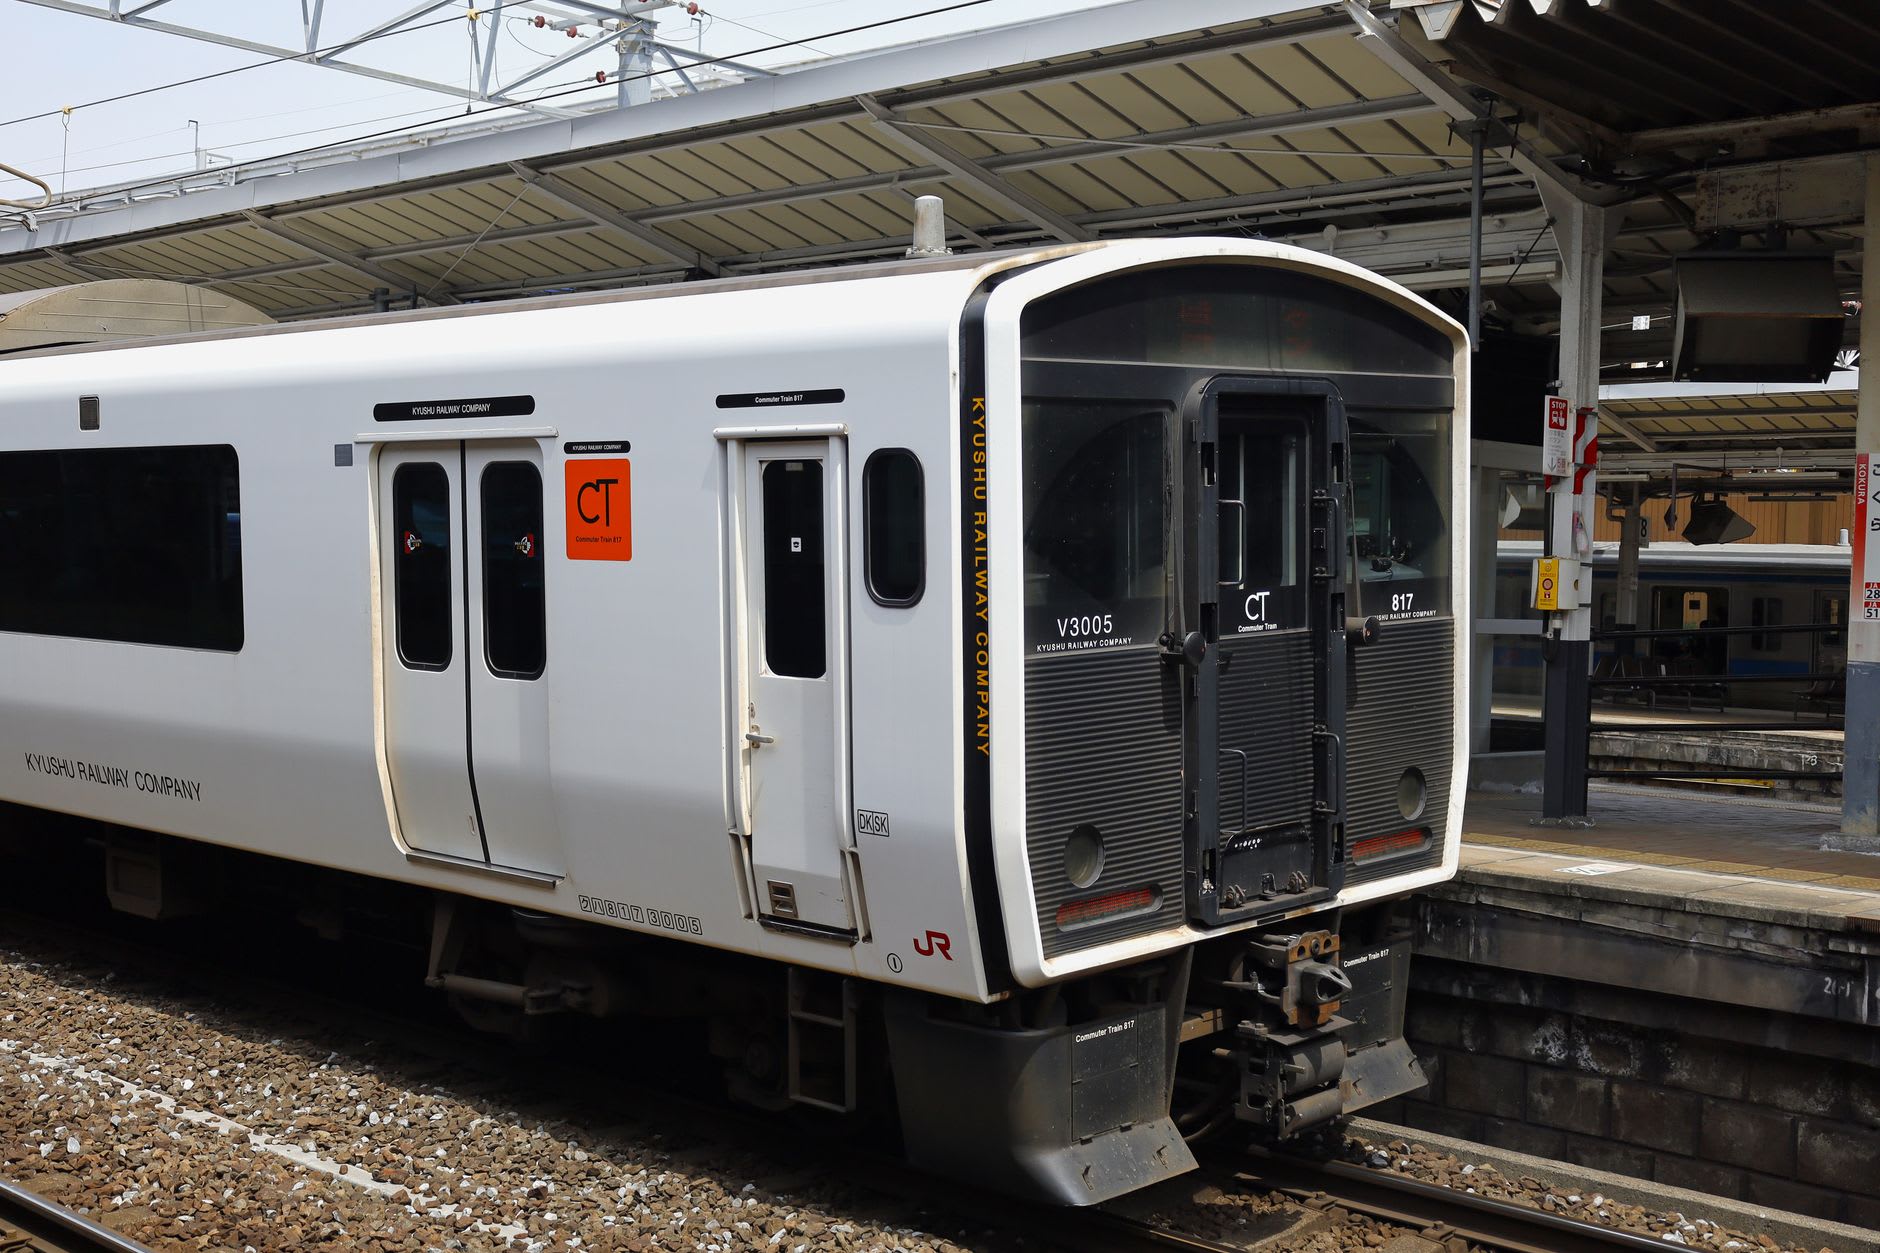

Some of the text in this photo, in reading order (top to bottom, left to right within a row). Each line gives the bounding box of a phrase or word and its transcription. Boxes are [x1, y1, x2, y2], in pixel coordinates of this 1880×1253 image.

[780, 394, 793, 402] Train
[793, 394, 803, 402] 817
[1551, 401, 1566, 409] STOP
[412, 403, 491, 415] KYUSHU RAILWAY COMPANY
[1857, 463, 1867, 505] KOKURA
[577, 479, 619, 527] CT
[1640, 519, 1648, 538] 8
[972, 397, 991, 757] KYUSHU RAILWAY COMPANY
[1391, 592, 1414, 611] 817
[1866, 589, 1880, 599] 28
[1245, 591, 1270, 621] CT
[1389, 612, 1412, 620] RAILWAY
[1412, 610, 1437, 618] COMPANY
[1866, 608, 1879, 618] 51
[1057, 614, 1112, 637] V3005
[1237, 622, 1278, 633] Commuter Train
[1036, 637, 1132, 652] KYUSHU RAILWAY COMPANY
[25, 752, 201, 802] KYUSHU RAILWAY COMPANY
[647, 909, 703, 935] 3005
[913, 930, 953, 961] JR
[1343, 948, 1389, 968] Commuter Train 817
[1075, 1020, 1135, 1043] Commuter Train 817
